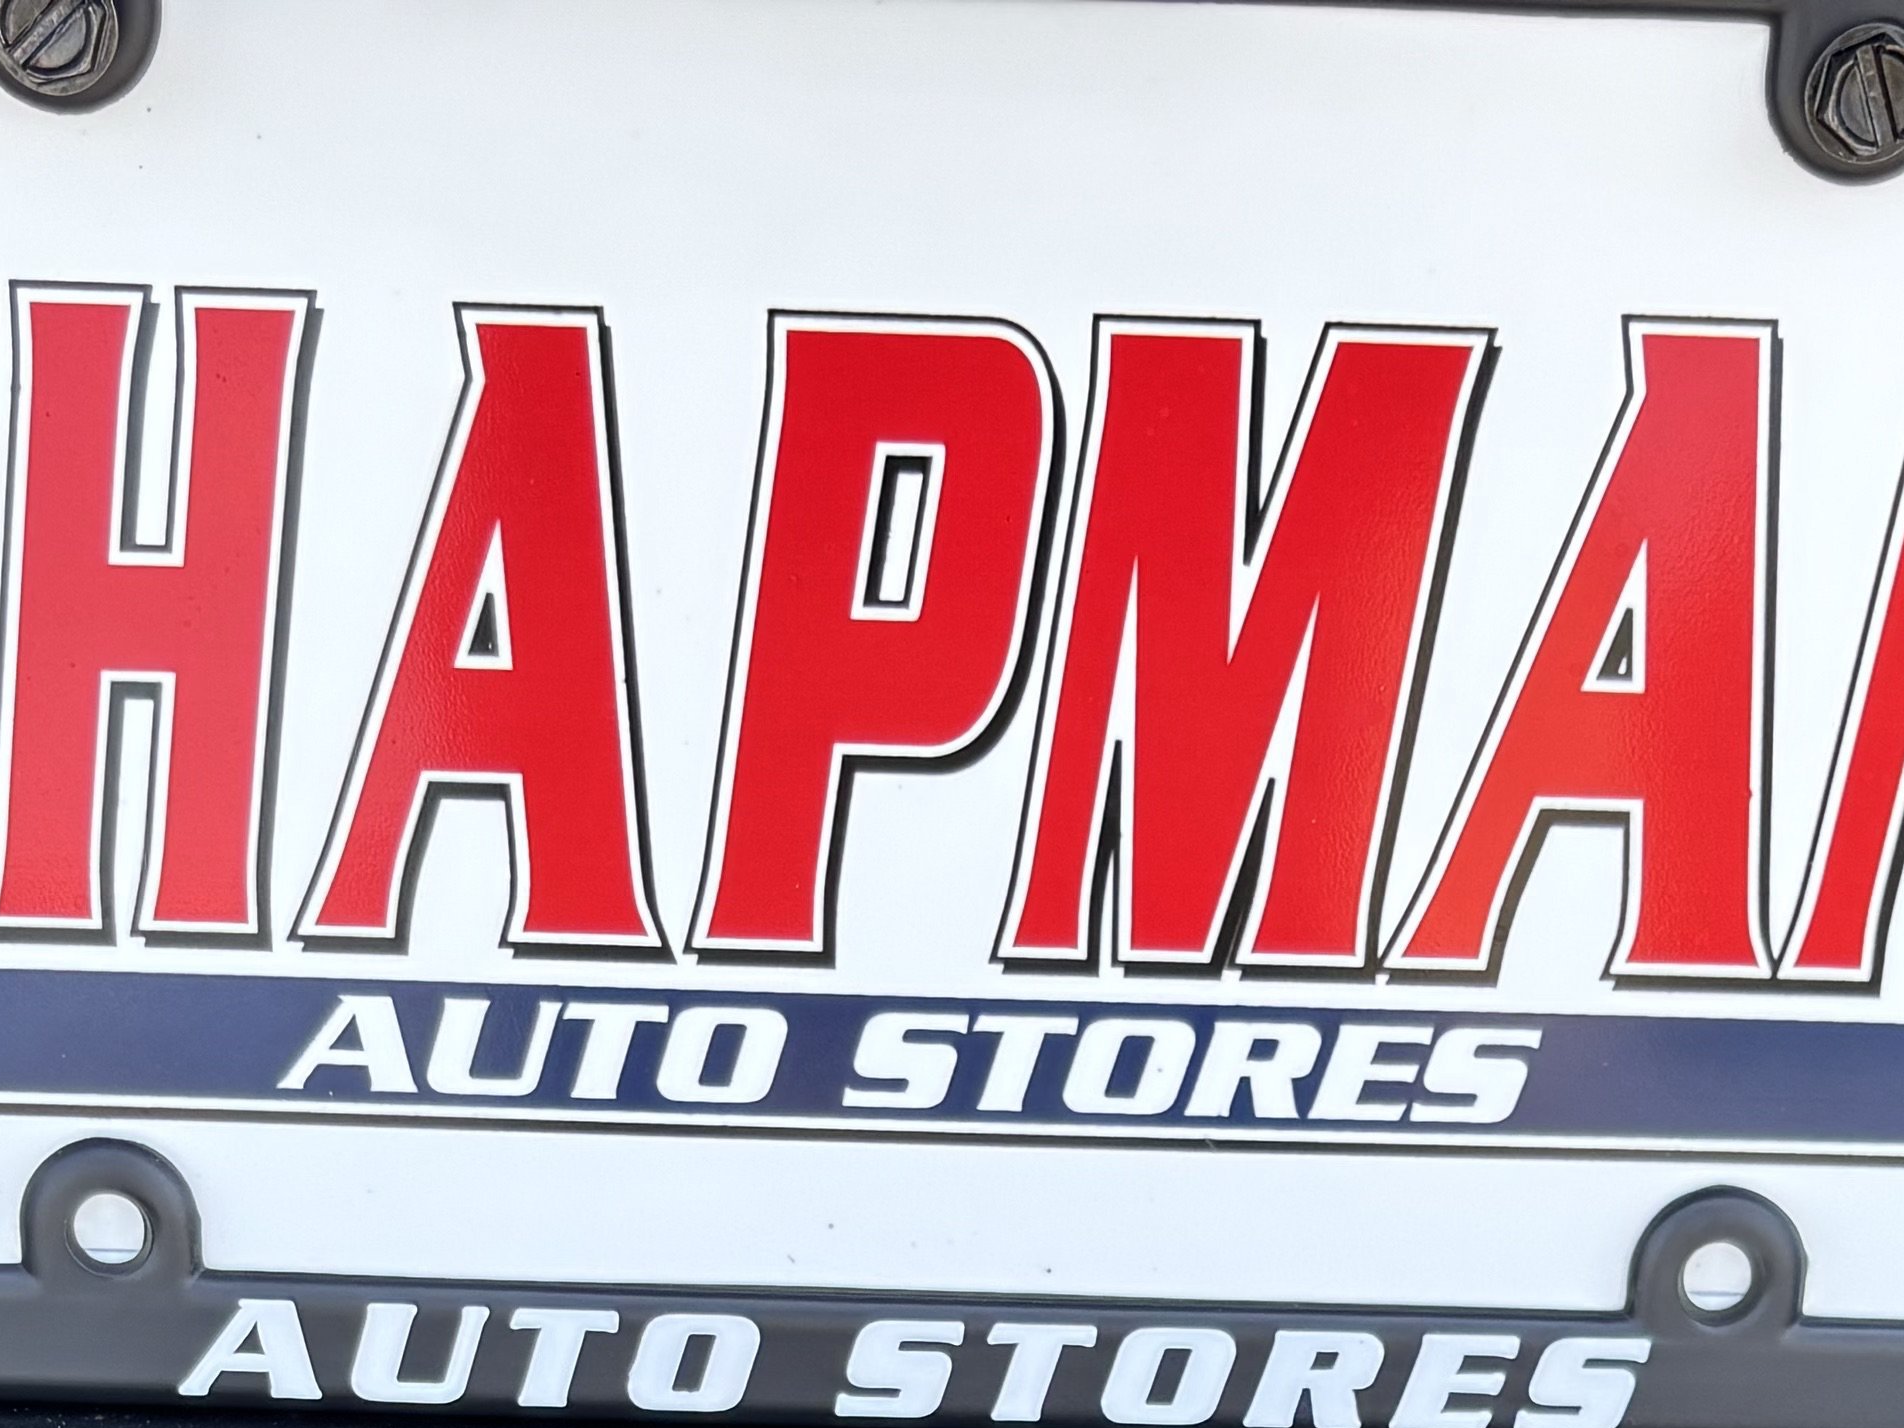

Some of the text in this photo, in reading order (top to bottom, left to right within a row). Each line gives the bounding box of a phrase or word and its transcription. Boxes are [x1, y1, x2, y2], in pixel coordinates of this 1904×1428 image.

[276, 995, 1542, 1123] AUTO STORES
[178, 1299, 761, 1413] AUTO
